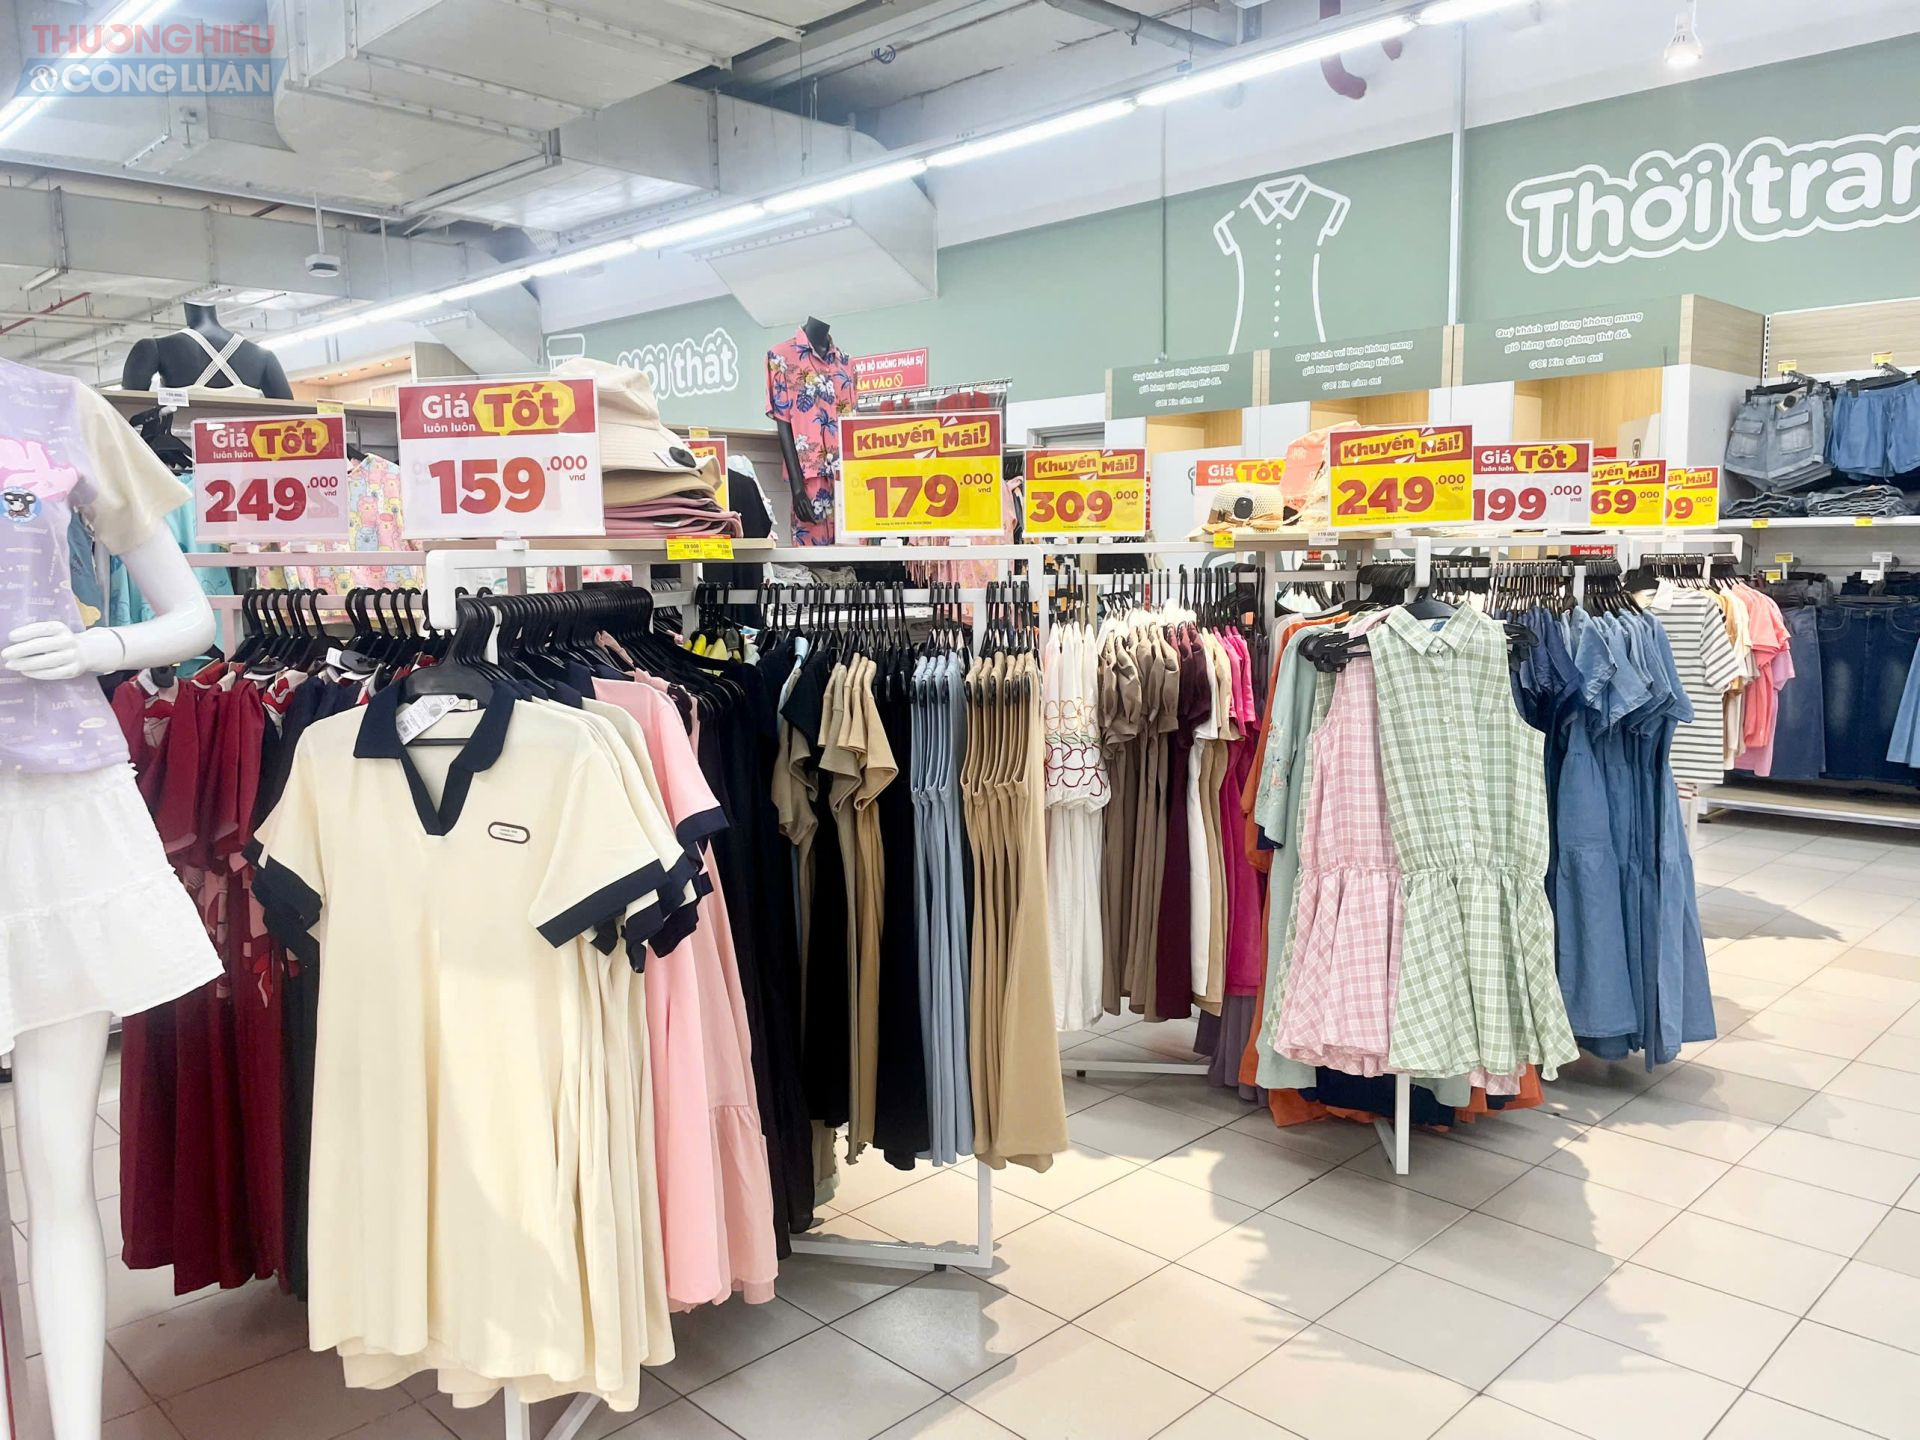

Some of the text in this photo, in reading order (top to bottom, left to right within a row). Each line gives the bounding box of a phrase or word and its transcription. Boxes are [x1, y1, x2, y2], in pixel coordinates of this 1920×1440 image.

[1519, 157, 1713, 259] Thời
[1515, 324, 1543, 335] khách
[1544, 321, 1558, 331] vui
[1583, 316, 1613, 328] không
[1615, 312, 1643, 324] mang
[421, 384, 560, 427] Giá Tốt
[212, 421, 317, 455] Giá Tốt
[424, 422, 476, 433] luôn luôn
[857, 424, 987, 450] Khuyến Mãi!
[1344, 434, 1460, 459] Khuyến Mãi!
[1481, 445, 1567, 470] Giá Tốt
[569, 473, 586, 481] vnd
[1037, 455, 1135, 474] Khuyến Mãi!
[1208, 459, 1282, 481] Giá Tốt
[1592, 465, 1623, 478] uyến
[428, 456, 546, 514] 159
[866, 474, 959, 519] 179
[1337, 476, 1435, 515] 249
[205, 477, 307, 523] 249
[1029, 490, 1113, 523] 309
[1473, 487, 1547, 522] 199
